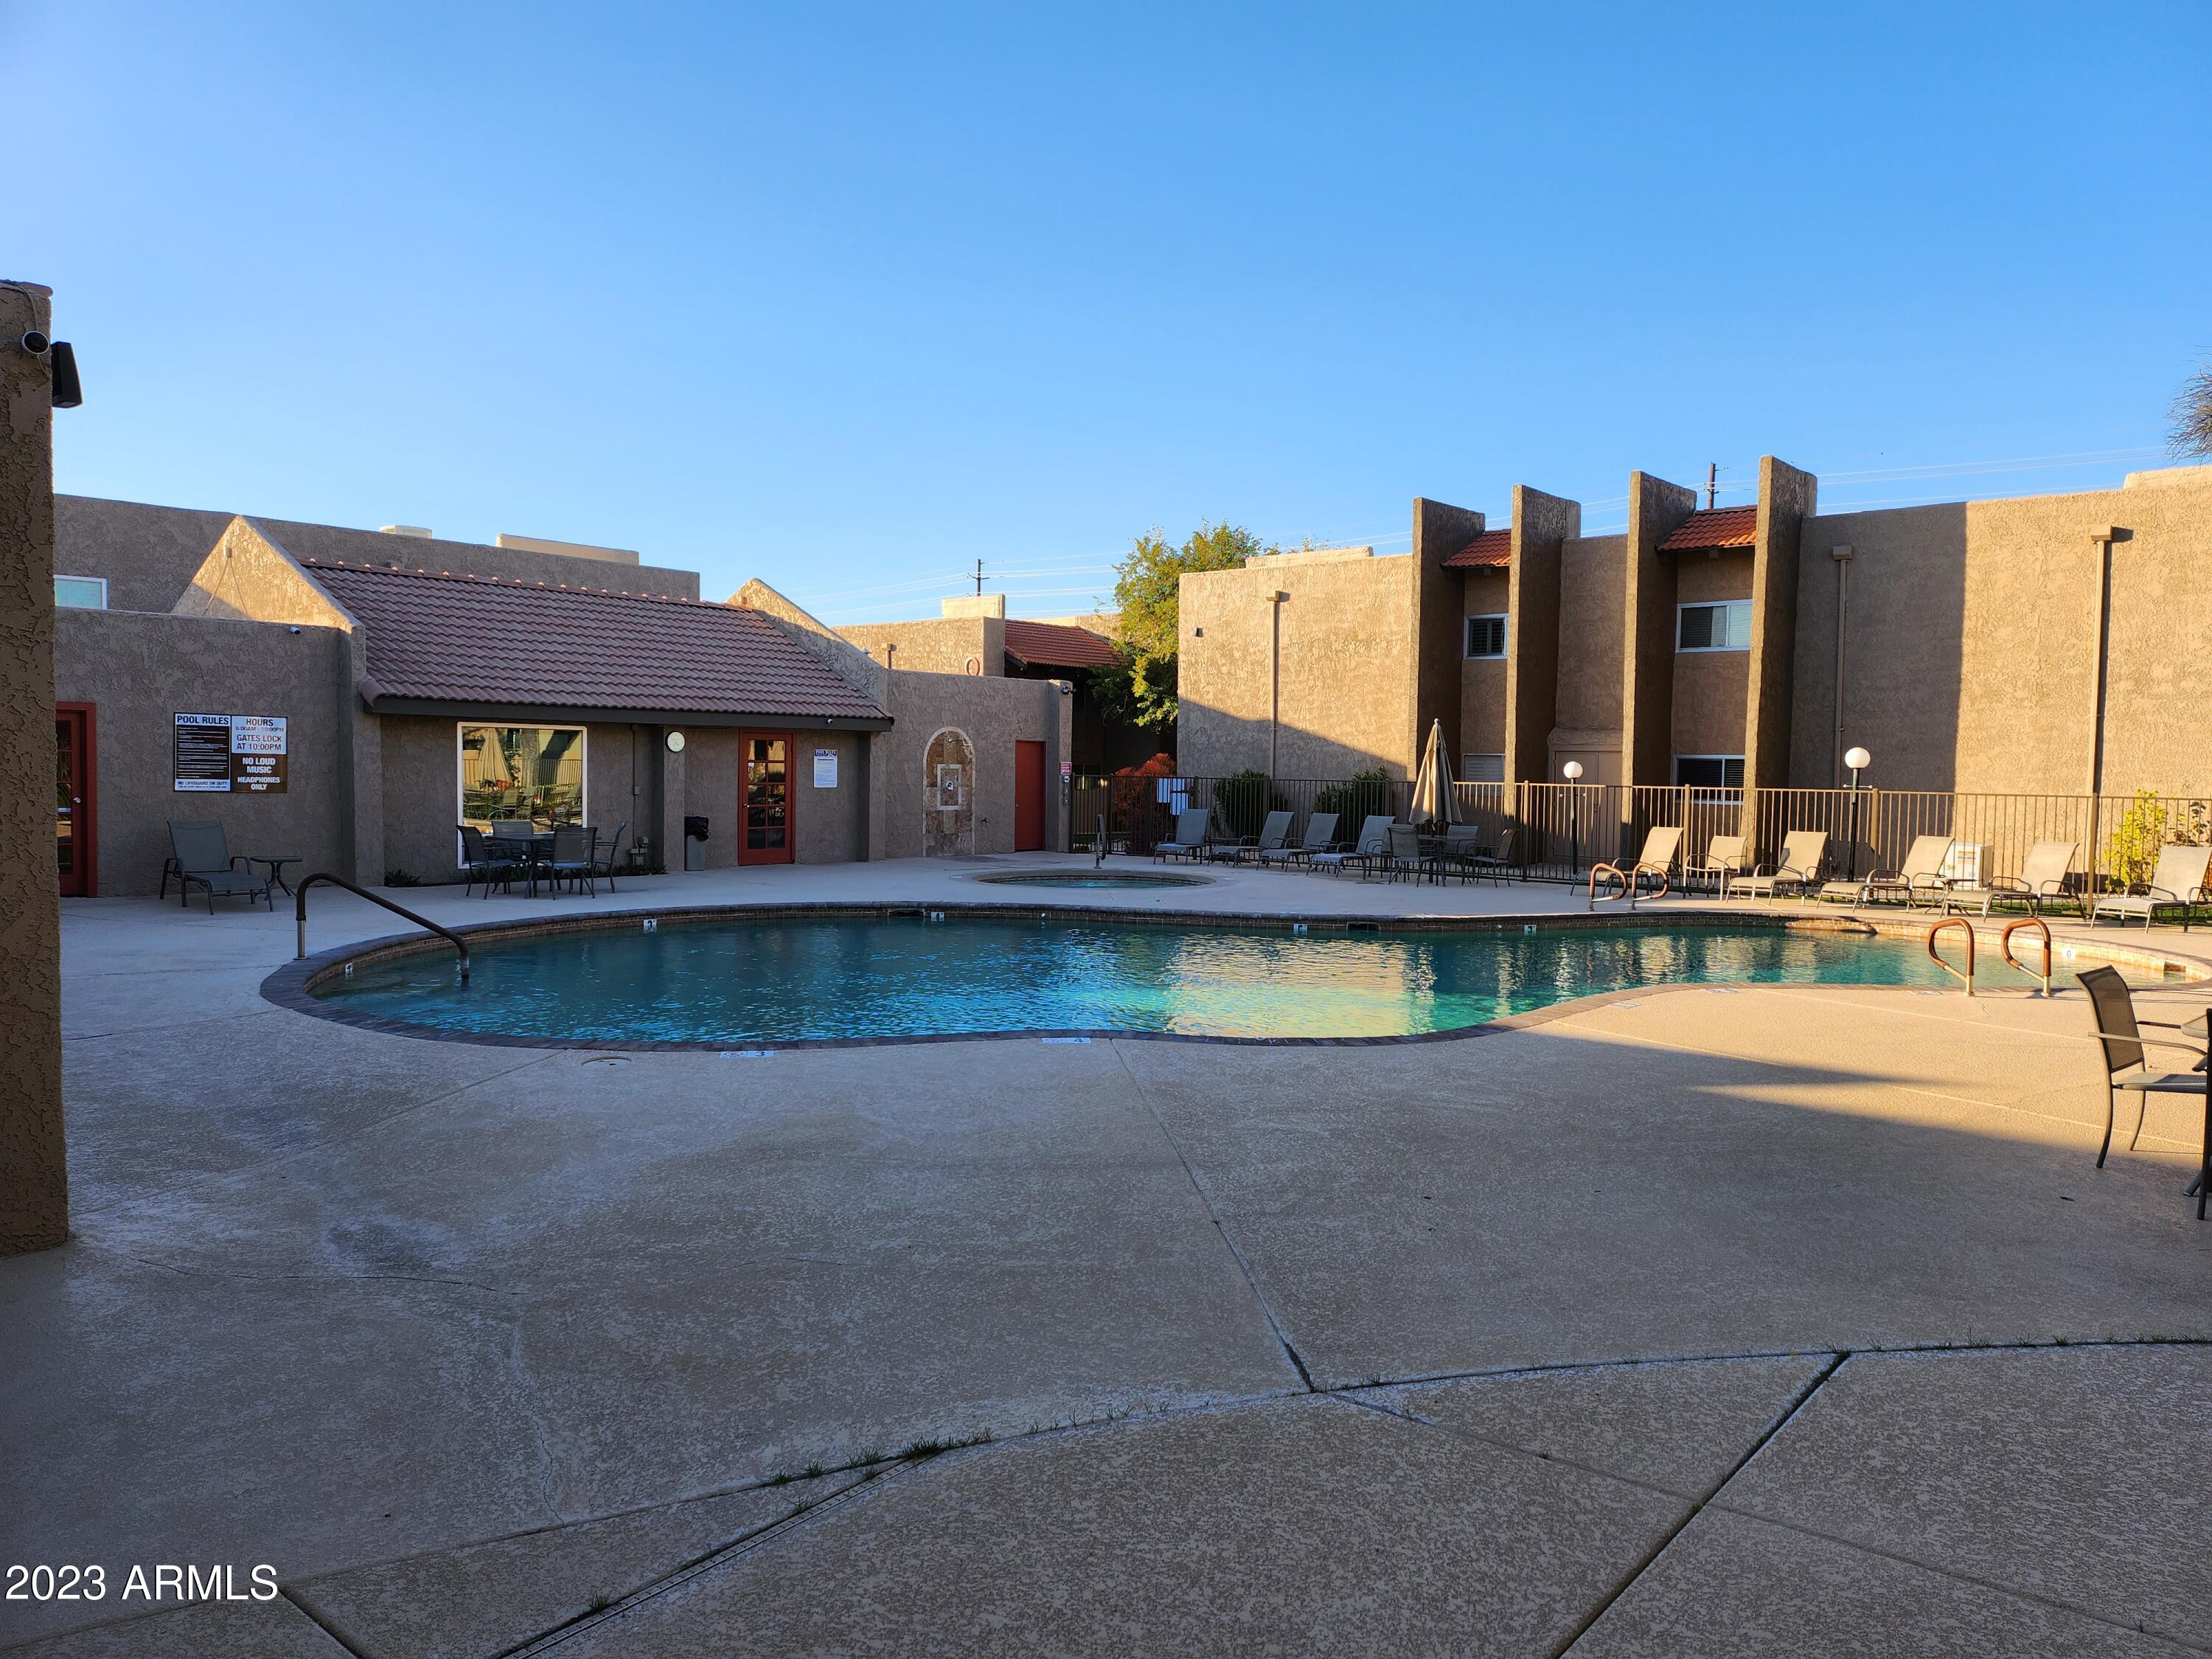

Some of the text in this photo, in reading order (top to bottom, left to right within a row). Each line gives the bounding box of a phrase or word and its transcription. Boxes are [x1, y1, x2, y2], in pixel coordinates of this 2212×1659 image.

[177, 715, 229, 725] POOL RULES
[246, 718, 274, 726] HOURS
[255, 757, 276, 765] LOUD
[246, 765, 272, 773] MUSIC
